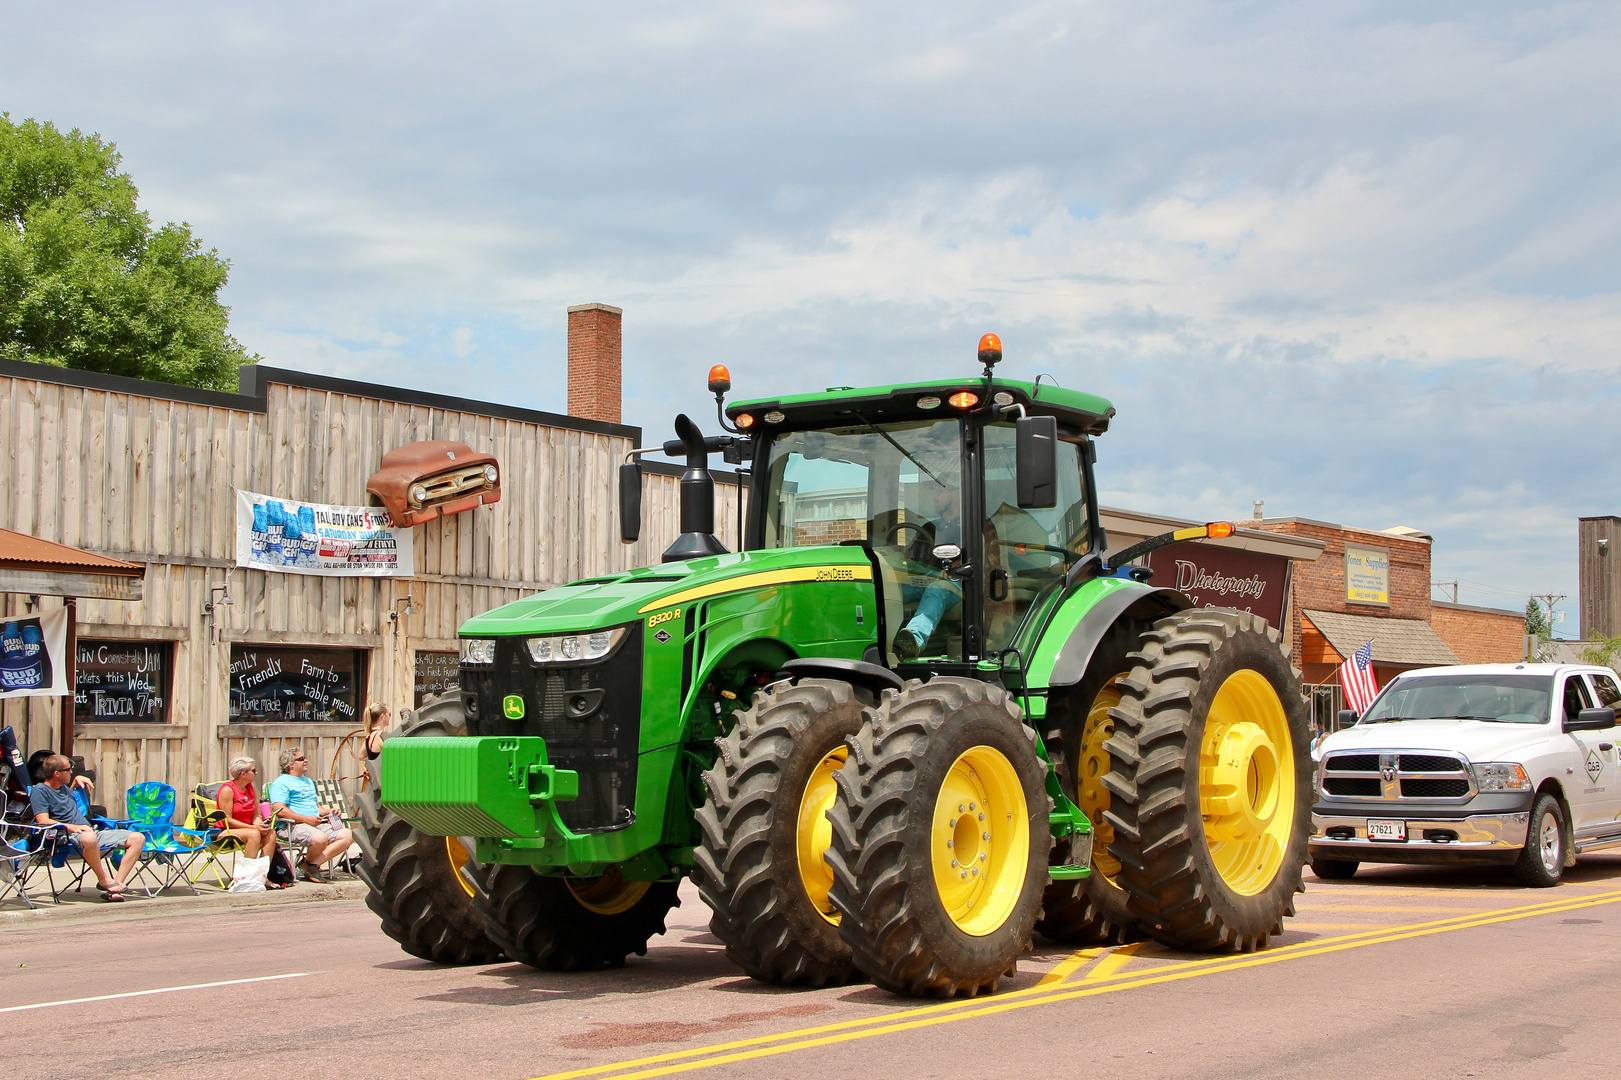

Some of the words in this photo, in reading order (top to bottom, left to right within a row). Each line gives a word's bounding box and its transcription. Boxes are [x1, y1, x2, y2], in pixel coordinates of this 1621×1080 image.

[316, 511, 332, 525] TAL
[332, 513, 346, 527] BOY
[346, 514, 363, 527] CANS
[371, 515, 384, 526] FOR
[318, 528, 357, 540] SATURDAY
[282, 538, 300, 548] BUD
[1175, 560, 1266, 599] Photography
[648, 610, 673, 628] 8320
[674, 608, 682, 620] R
[4, 638, 21, 647] BUD
[424, 654, 434, 664] 40
[2, 668, 36, 680] BUD
[300, 658, 324, 680] Farm
[328, 664, 339, 683] to
[2, 672, 41, 686] LIGHT
[106, 672, 124, 682] this
[75, 690, 88, 704] at
[90, 690, 134, 716] TRIVIA
[303, 682, 330, 704] table
[332, 698, 355, 716] menu
[1588, 762, 1600, 772] C&B
[1370, 825, 1393, 834] 27621
[1398, 826, 1403, 834] V
